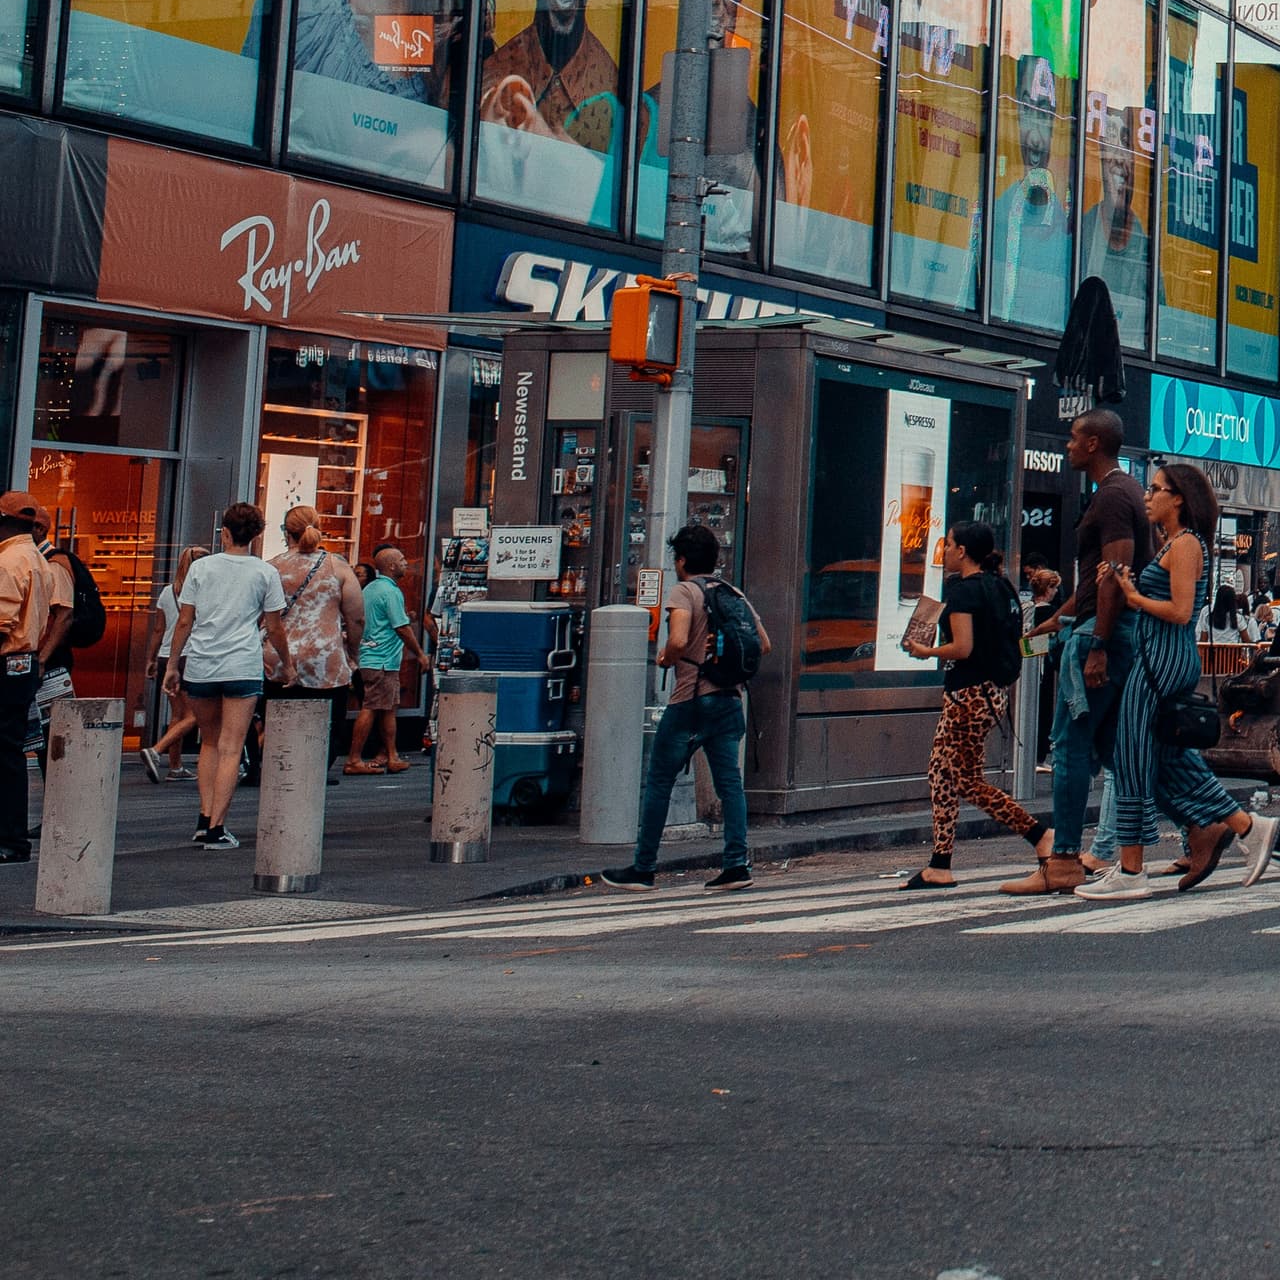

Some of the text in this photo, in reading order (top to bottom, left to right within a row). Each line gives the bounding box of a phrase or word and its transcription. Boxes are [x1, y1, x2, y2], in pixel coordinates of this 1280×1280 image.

[220, 198, 361, 313] Ray-Ban
[908, 379, 935, 393] JCDecaux
[511, 371, 534, 482] Newsstand
[904, 411, 936, 429] NESPRESSO
[1186, 407, 1250, 443] COLLECTIO
[1024, 449, 1064, 473] TISSOT
[1203, 461, 1239, 490] KIKO
[92, 510, 156, 524] WAYFARE
[498, 535, 553, 545] SOUVENIRS
